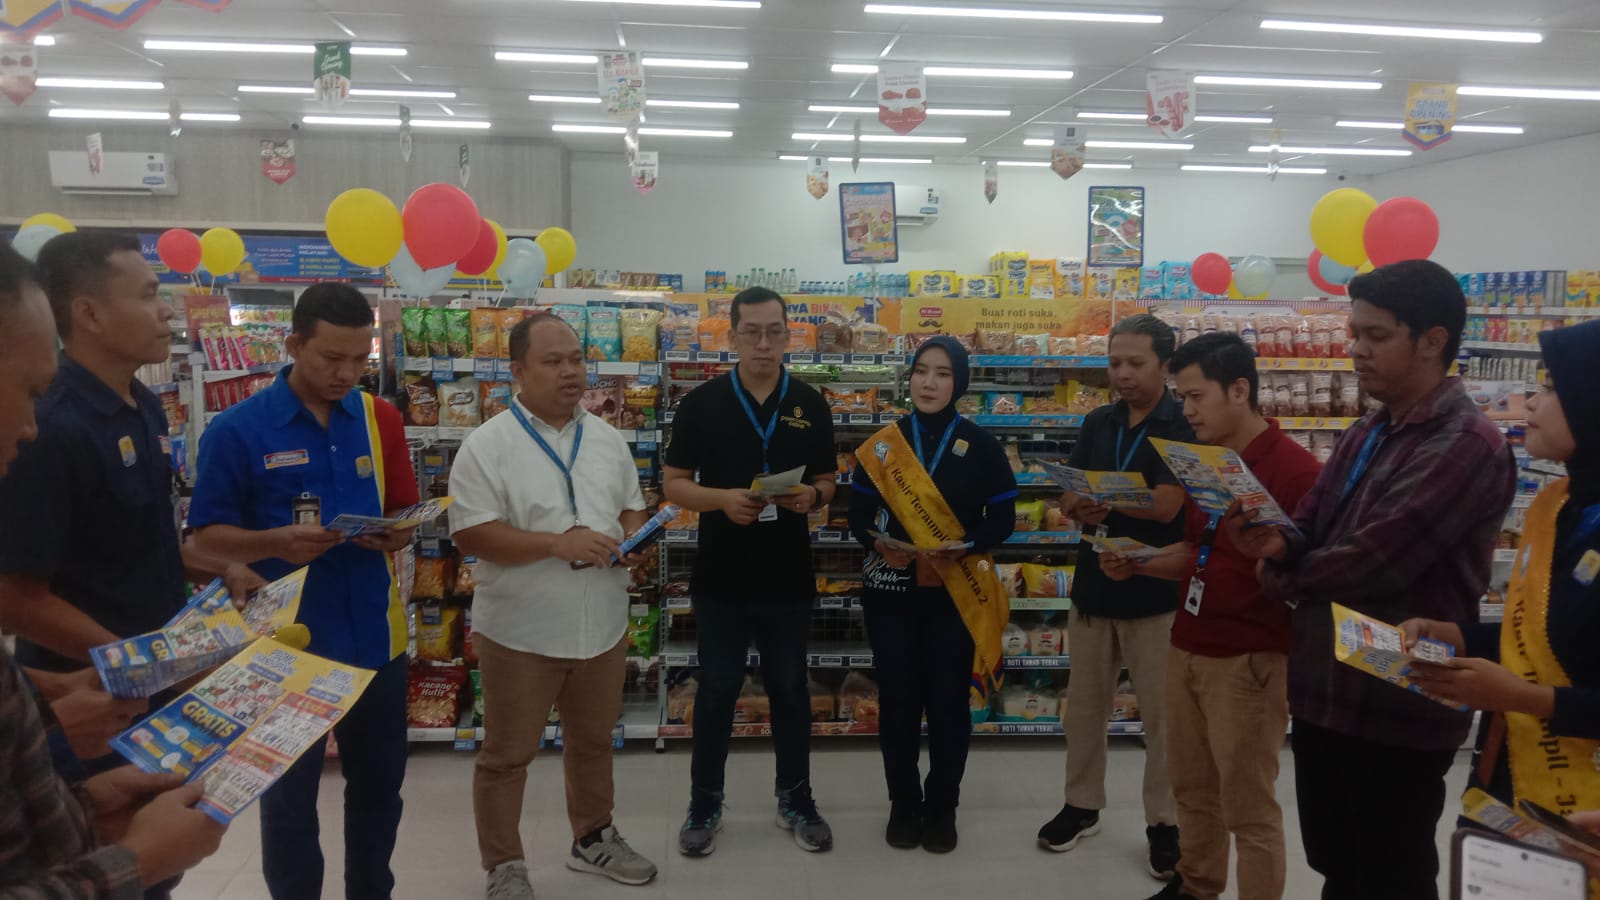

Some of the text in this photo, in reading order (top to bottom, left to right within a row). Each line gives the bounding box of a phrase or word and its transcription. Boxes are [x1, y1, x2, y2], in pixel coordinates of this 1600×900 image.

[981, 308, 1004, 317] Buat
[1007, 308, 1026, 317] roti
[976, 321, 1062, 331] makan juga suka
[891, 467, 950, 543] Kasir Terampi
[977, 594, 988, 606] 2
[181, 700, 239, 739] GRATIS
